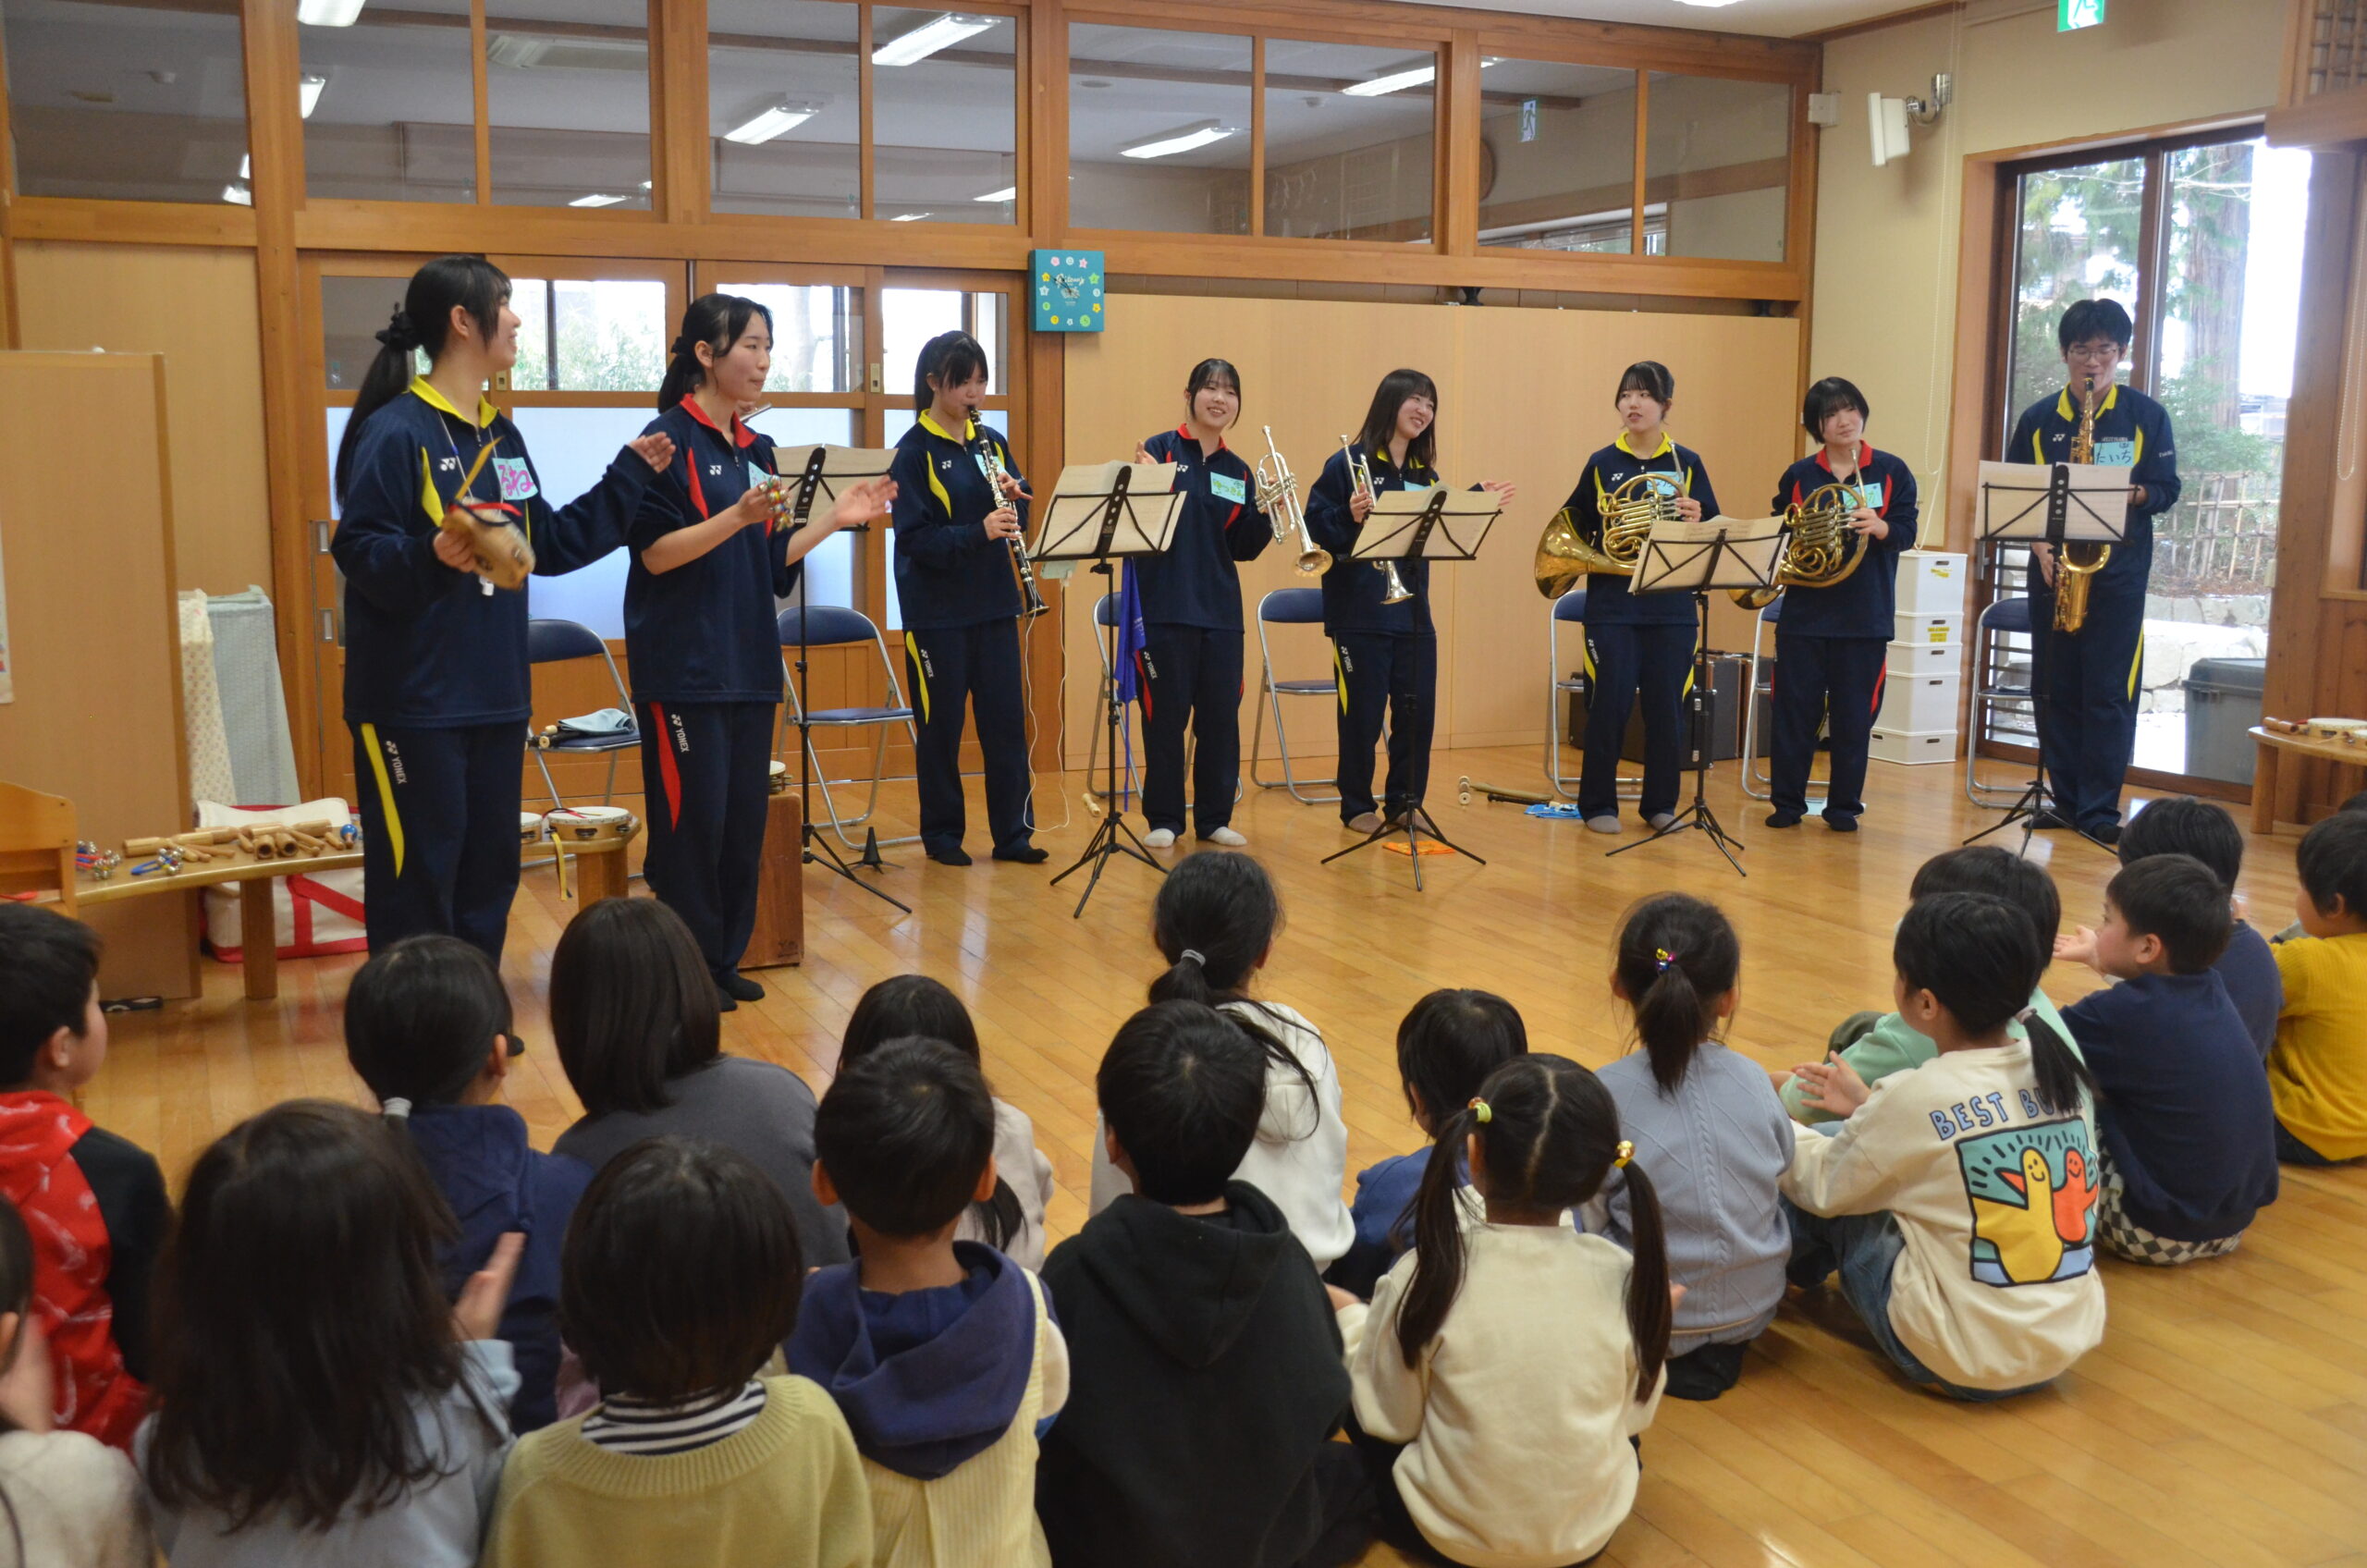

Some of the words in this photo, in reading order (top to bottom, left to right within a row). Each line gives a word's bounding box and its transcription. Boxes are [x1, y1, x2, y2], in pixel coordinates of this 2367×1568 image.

[925, 659, 934, 678] YONEX
[1147, 661, 1158, 680] YONEX
[1343, 655, 1354, 673] YONEX
[675, 728, 690, 753] YONEX
[392, 756, 407, 784] YONEX
[1929, 1092, 2008, 1140] BEST
